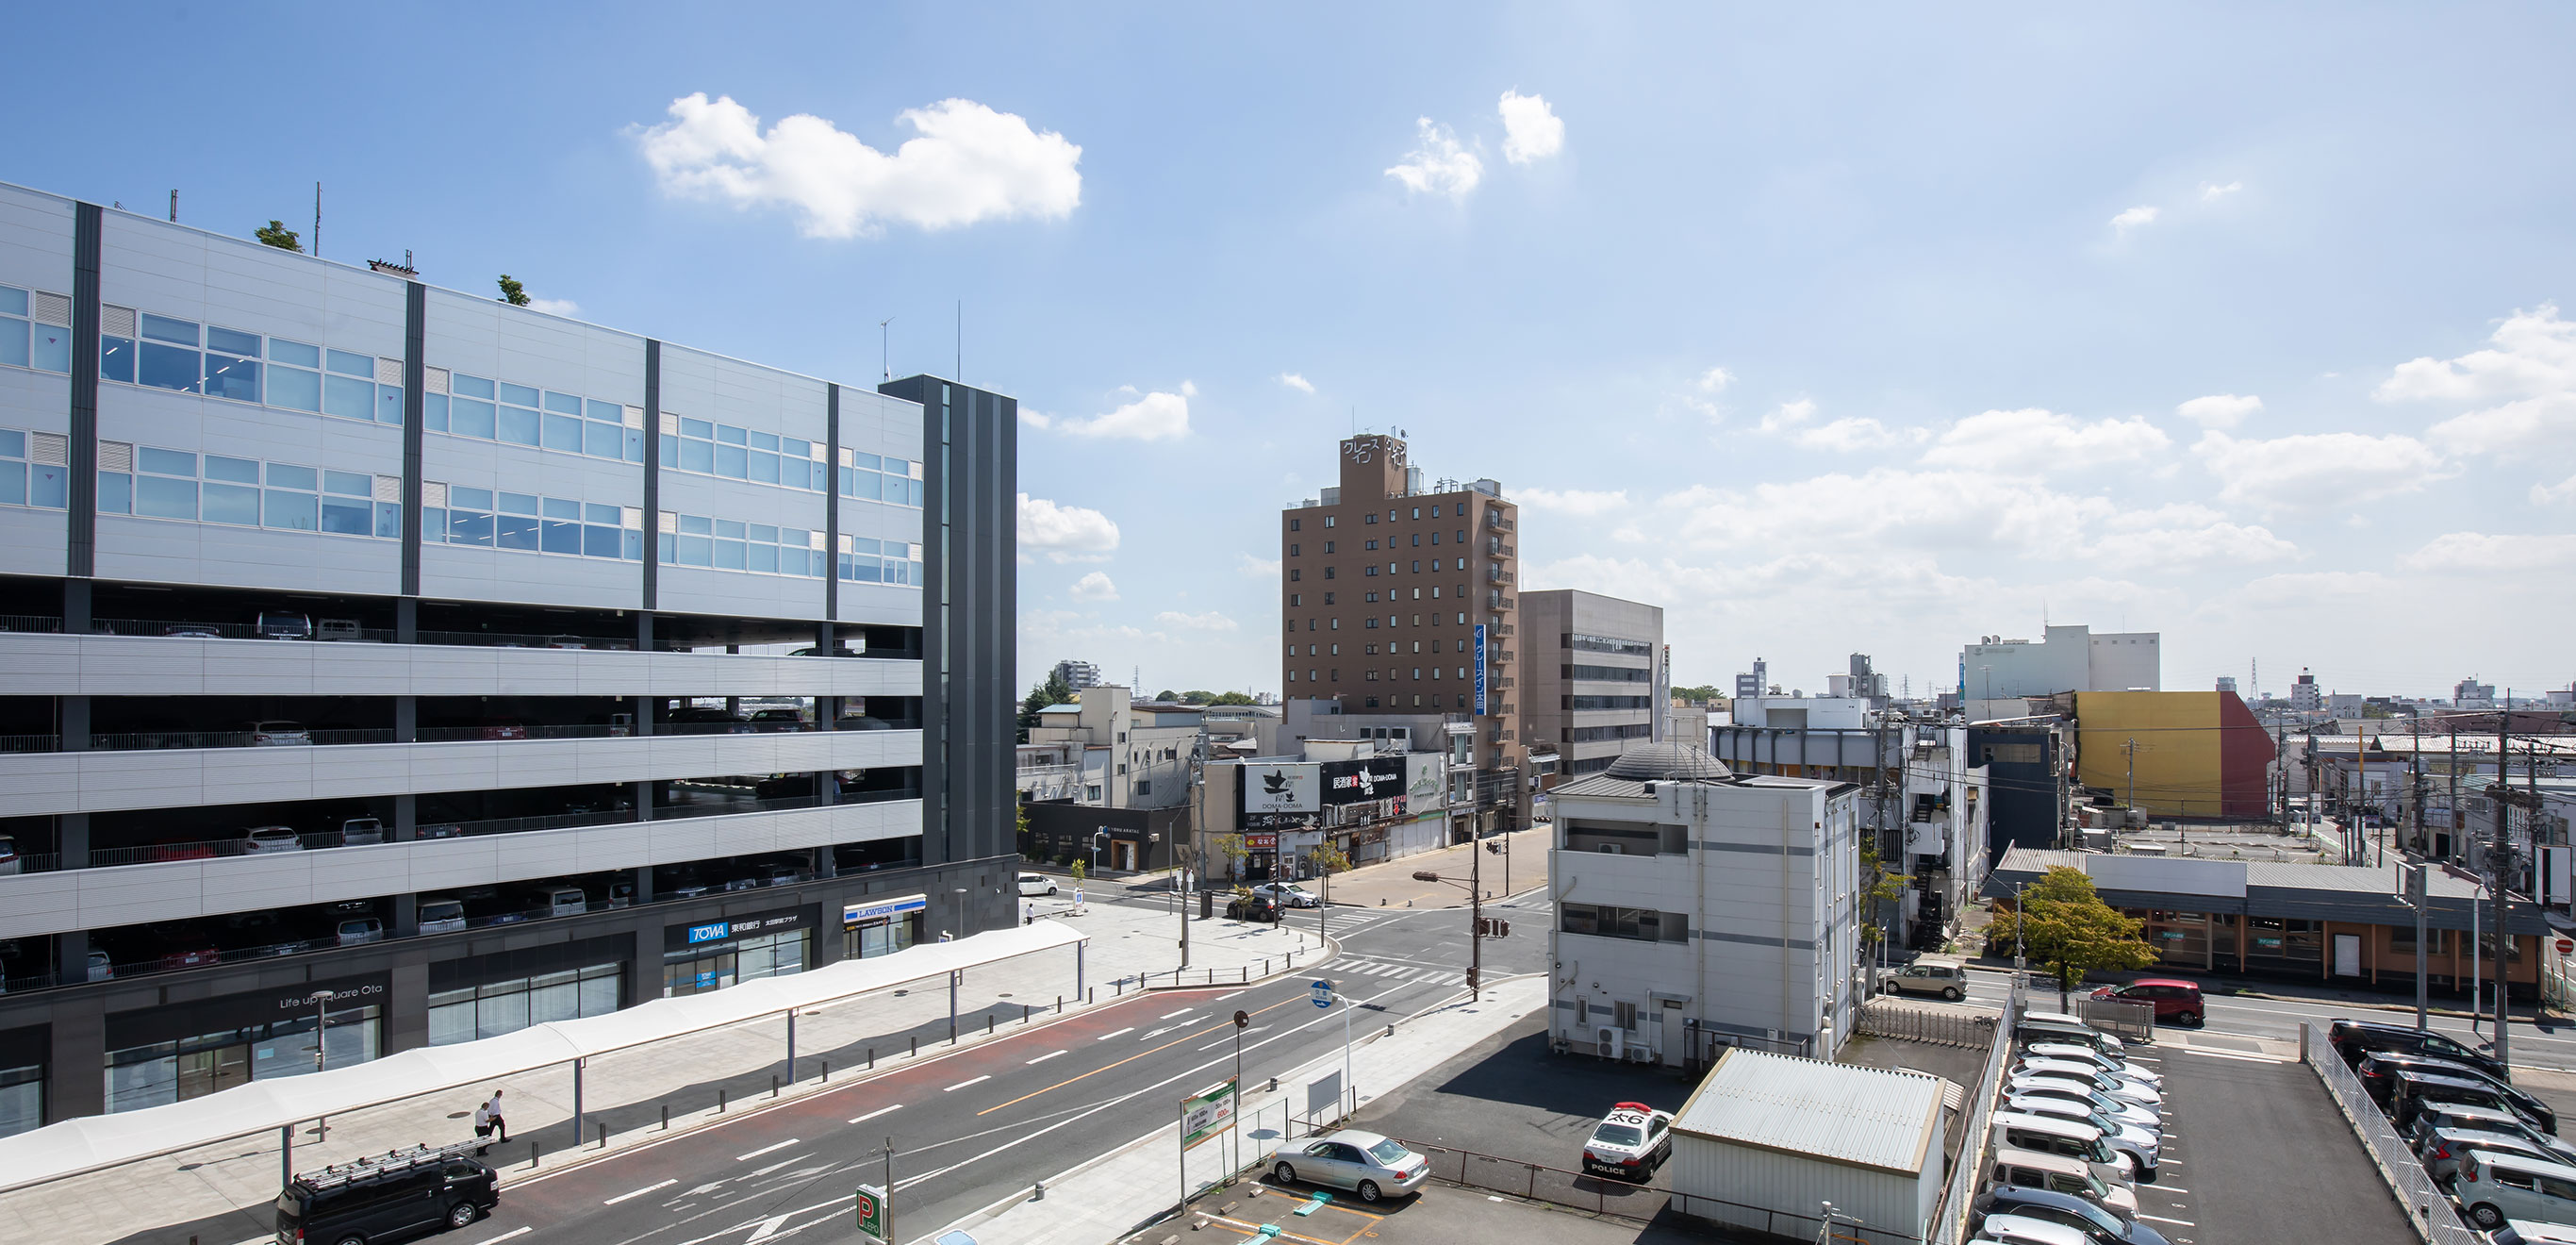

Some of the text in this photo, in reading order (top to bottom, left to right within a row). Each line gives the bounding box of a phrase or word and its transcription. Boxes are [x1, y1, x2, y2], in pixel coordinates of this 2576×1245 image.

[1352, 451, 1372, 464] イン
[1476, 644, 1484, 709] グレースイン太田
[859, 905, 893, 918] LAWSON
[693, 925, 724, 940] TOWA
[280, 985, 383, 1009] Life up quare Ota
[1608, 1113, 1644, 1124] 太6
[1592, 1163, 1626, 1175] POLICE
[859, 1194, 873, 1227] P
[864, 1220, 879, 1234] LEPO
